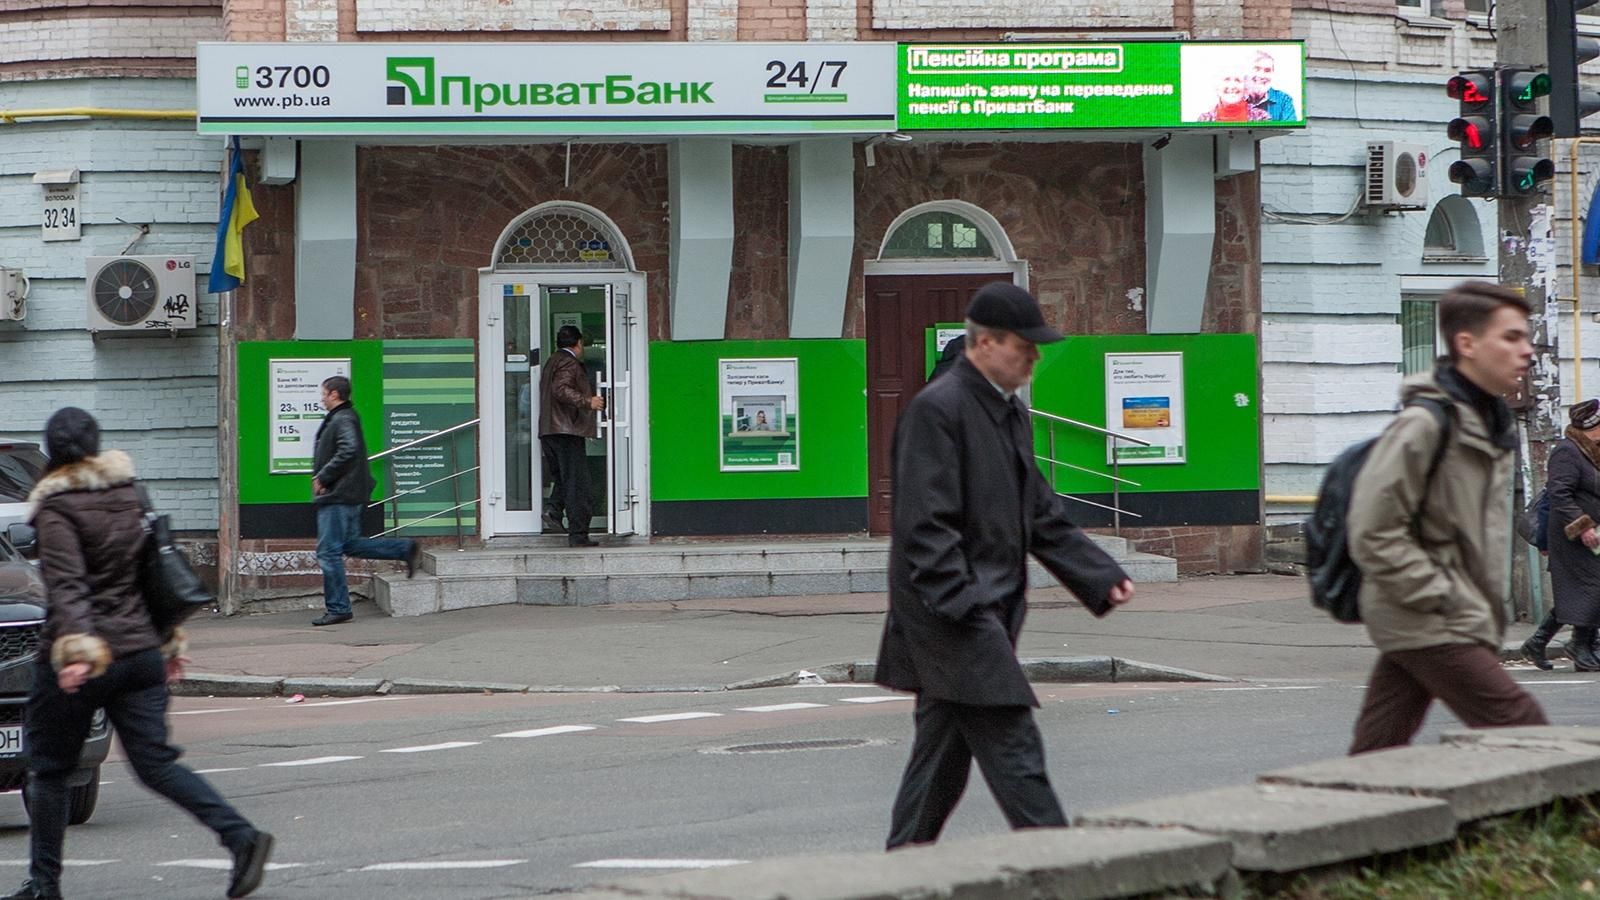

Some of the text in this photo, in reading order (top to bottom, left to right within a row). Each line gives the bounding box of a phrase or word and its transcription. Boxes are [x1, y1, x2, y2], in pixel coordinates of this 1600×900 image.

[912, 50, 1117, 69] Пенсійна програма
[255, 65, 331, 89] 3700
[765, 60, 848, 94] 24/7
[440, 75, 715, 113] ПриватБанк
[908, 83, 988, 98] Напишіть
[990, 85, 1038, 100] заяву
[1040, 85, 1061, 97] на
[233, 94, 331, 109] www.pb.ua
[908, 99, 959, 115] пенсії
[974, 98, 1075, 117] ПриватБанк
[44, 207, 76, 229] 32 34
[178, 261, 191, 269] LG
